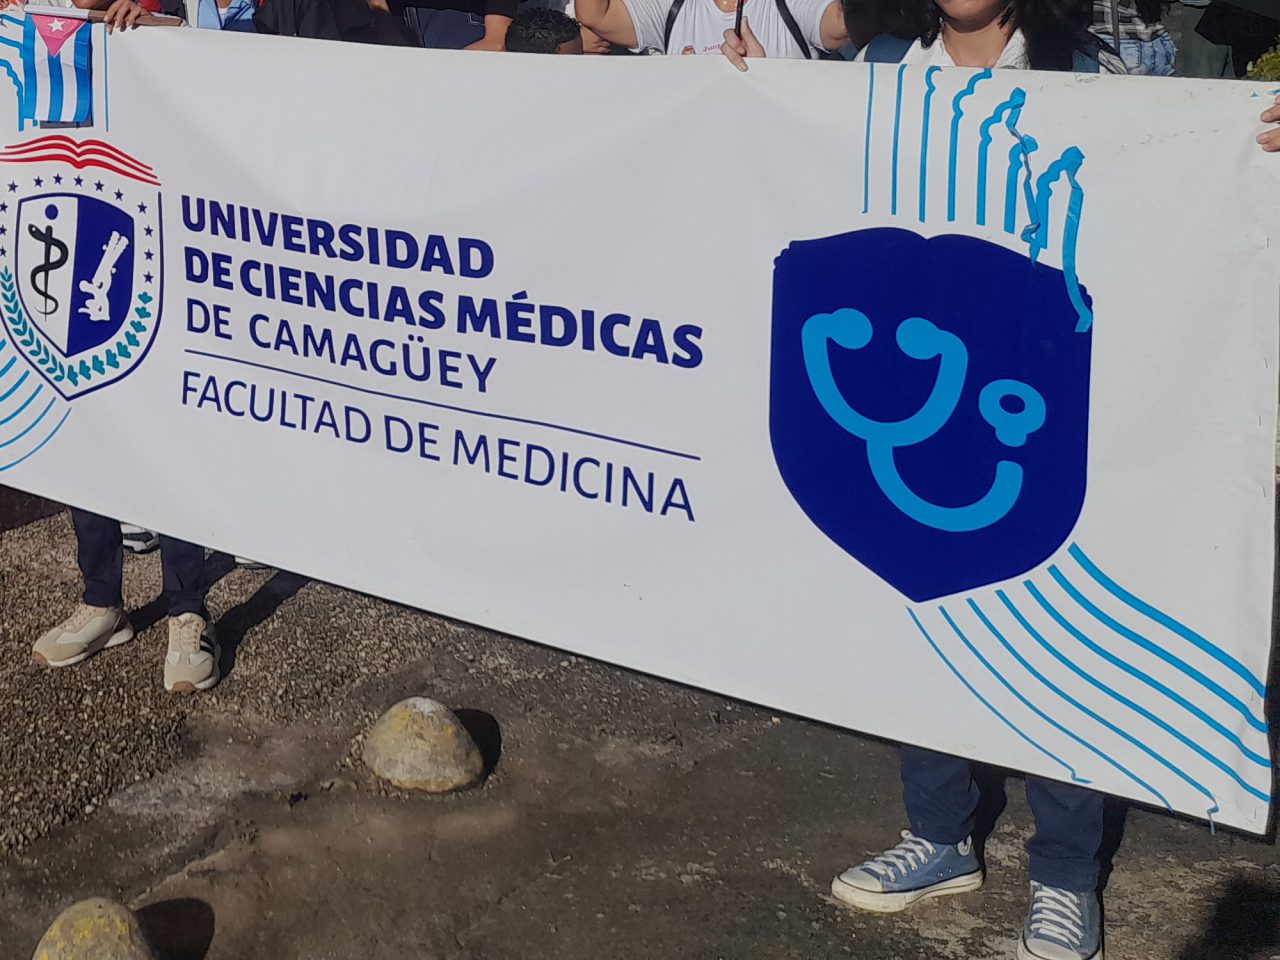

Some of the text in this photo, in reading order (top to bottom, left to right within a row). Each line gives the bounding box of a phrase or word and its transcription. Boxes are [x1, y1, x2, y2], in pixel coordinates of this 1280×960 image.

[181, 194, 495, 279] UNIVERSIDAD
[184, 246, 703, 369] DE CIENCIAS MÉDICAS
[186, 297, 497, 393] DE CAMAGÜEY
[182, 370, 695, 522] FACULTAD DE MEDICINA
